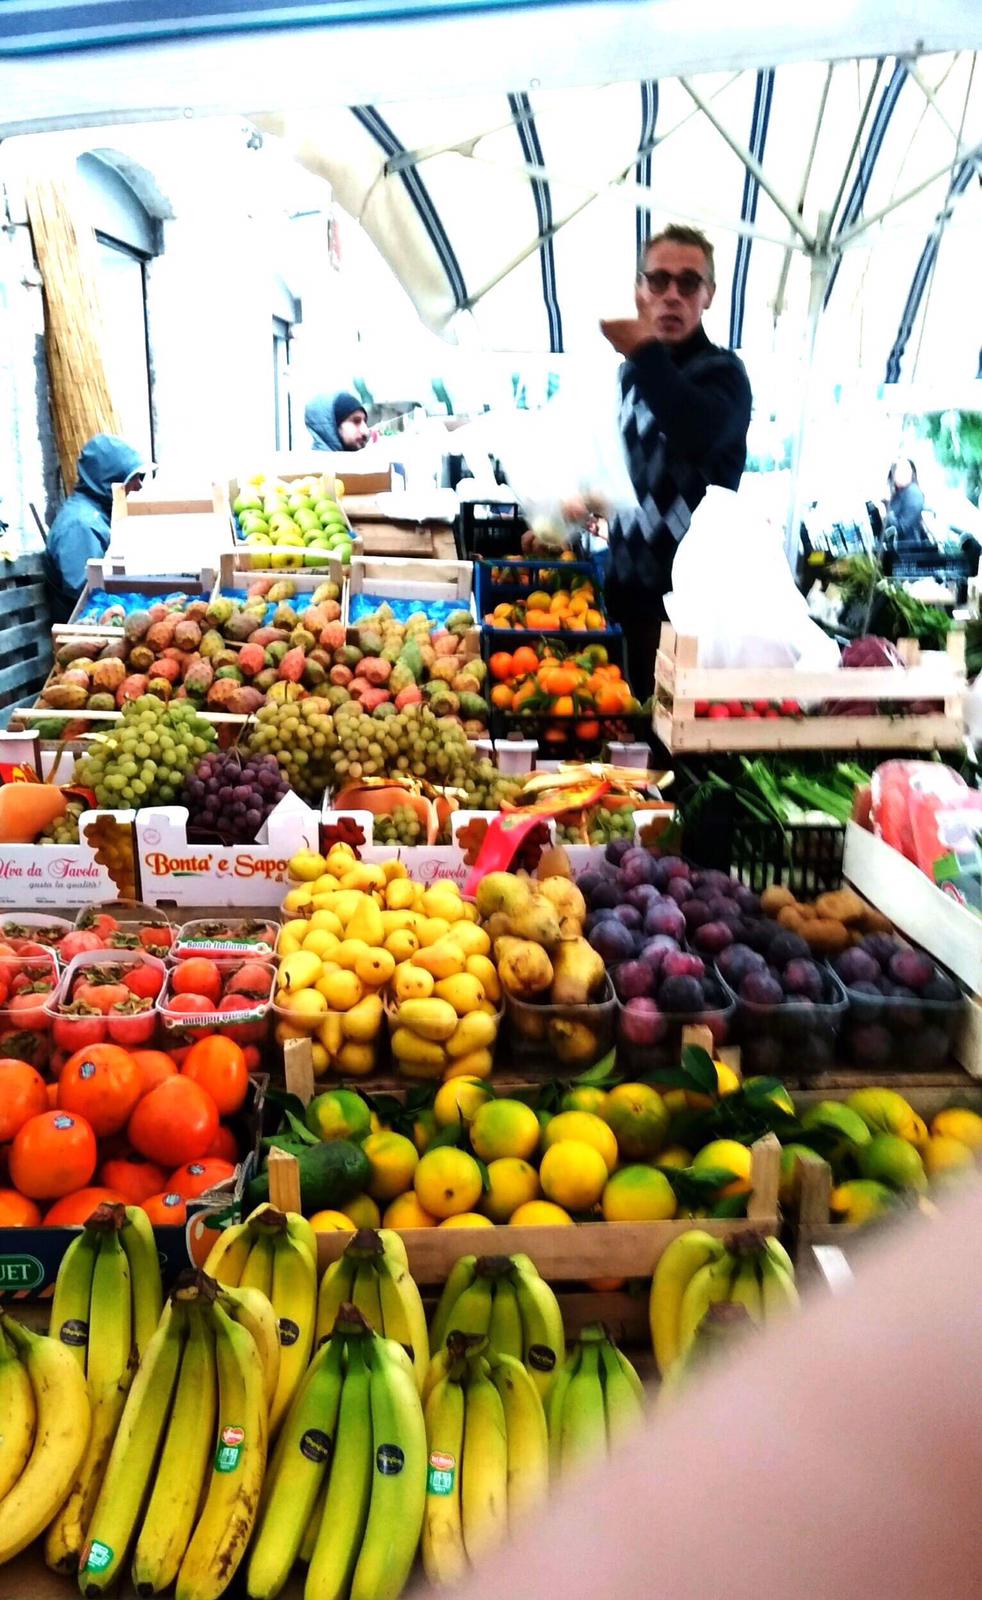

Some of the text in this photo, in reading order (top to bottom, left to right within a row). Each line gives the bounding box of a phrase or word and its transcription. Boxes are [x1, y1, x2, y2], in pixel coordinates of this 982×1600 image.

[27, 862, 42, 877] da
[48, 858, 99, 878] Tavola
[145, 852, 289, 879] Bonta' e Sapo
[419, 859, 467, 879] Tavola
